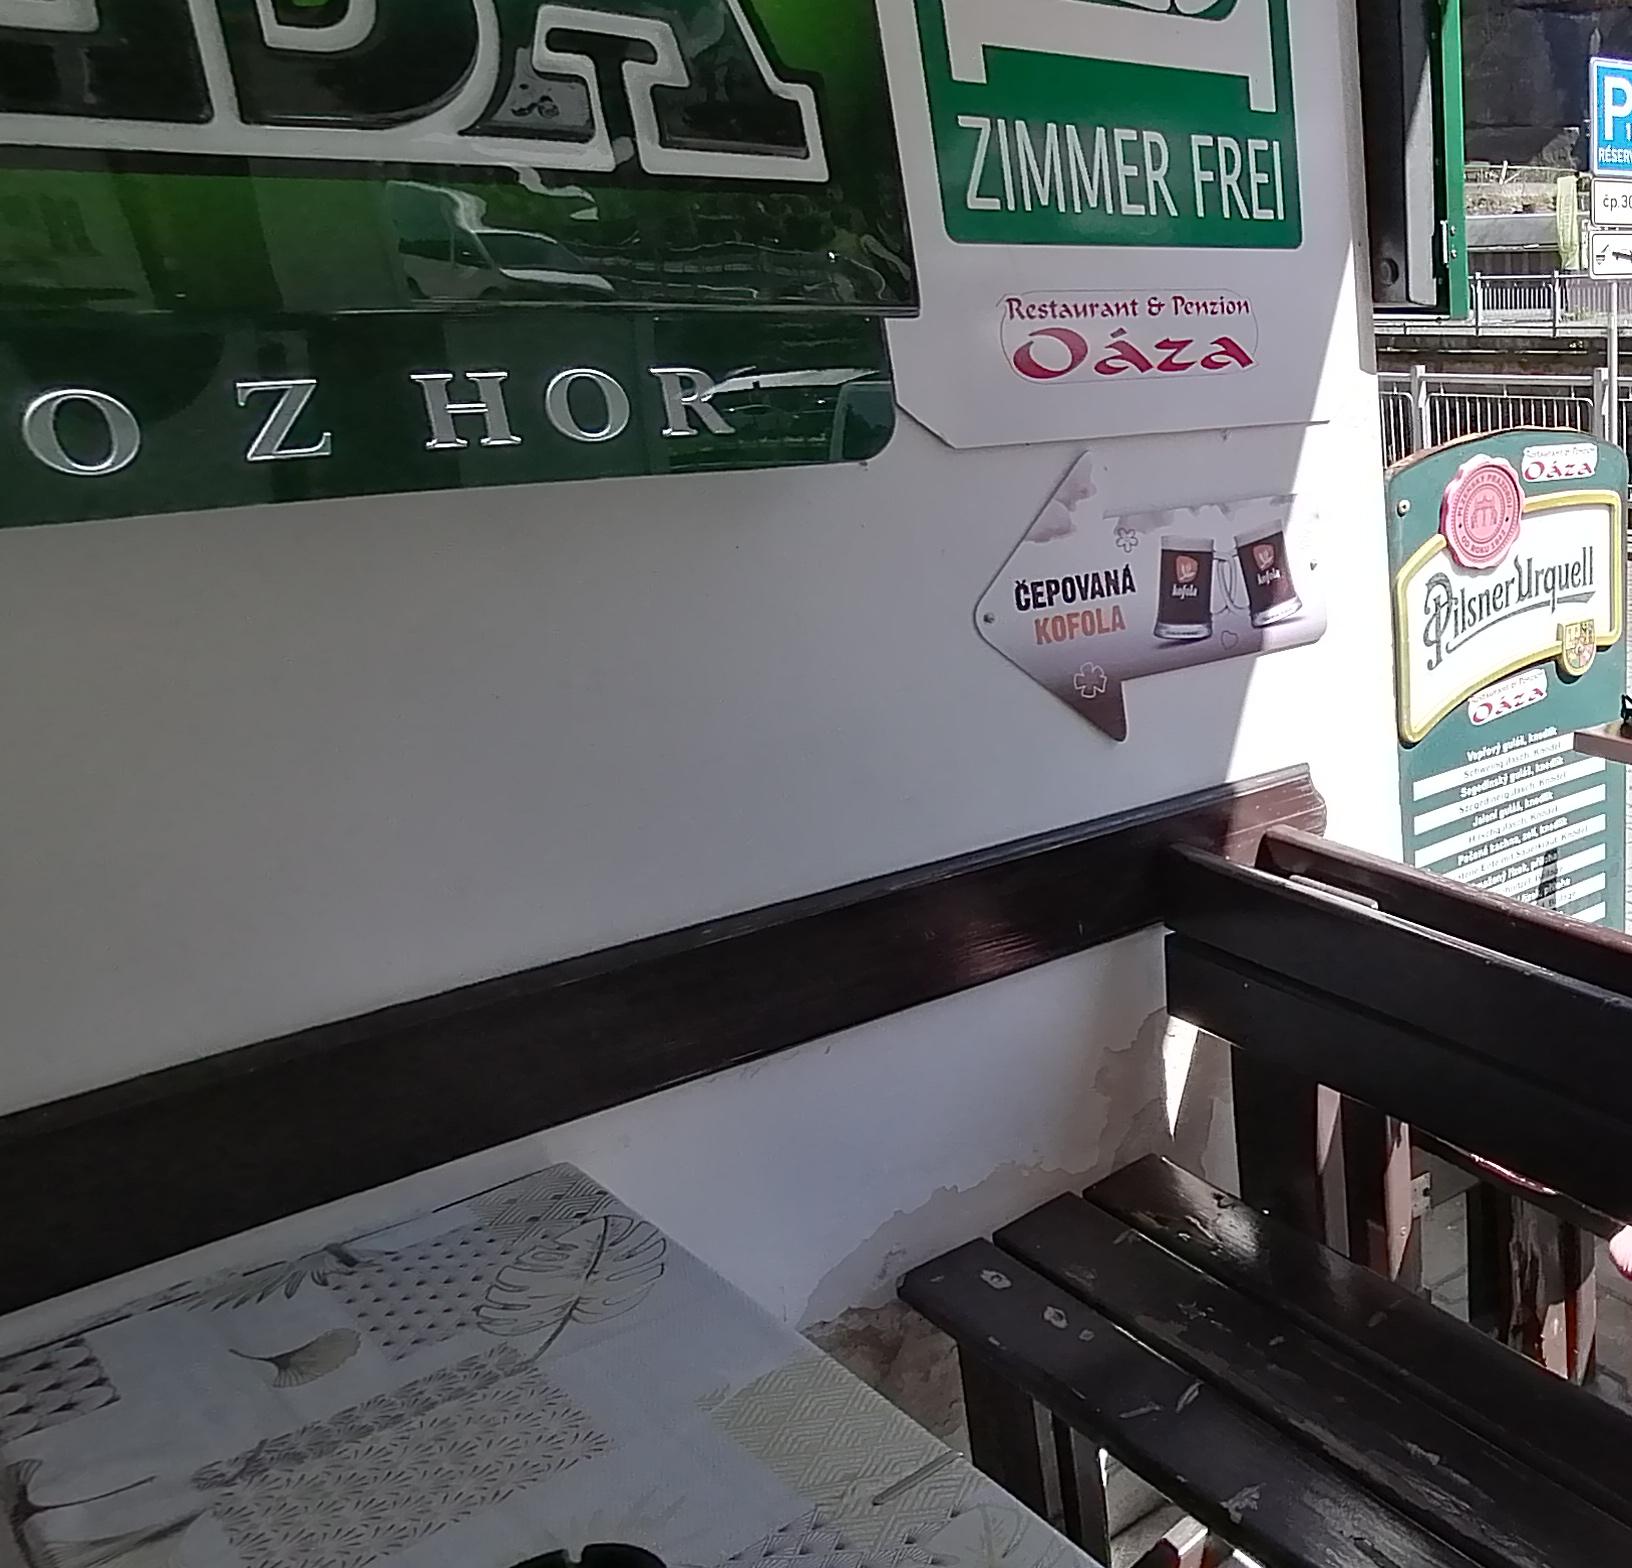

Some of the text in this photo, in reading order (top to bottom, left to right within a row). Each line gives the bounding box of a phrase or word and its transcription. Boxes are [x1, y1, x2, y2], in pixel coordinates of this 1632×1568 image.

[957, 115, 1285, 220] ZIMMER FREI
[1006, 296, 1250, 320] Restaurant & Penzion
[1013, 327, 1254, 379] Oáza
[1525, 460, 1592, 480] Oáza
[1014, 564, 1136, 612] ČEPOVANÁ
[1423, 545, 1594, 671] Pilsner Urquell
[1034, 604, 1127, 646] KOFOLA
